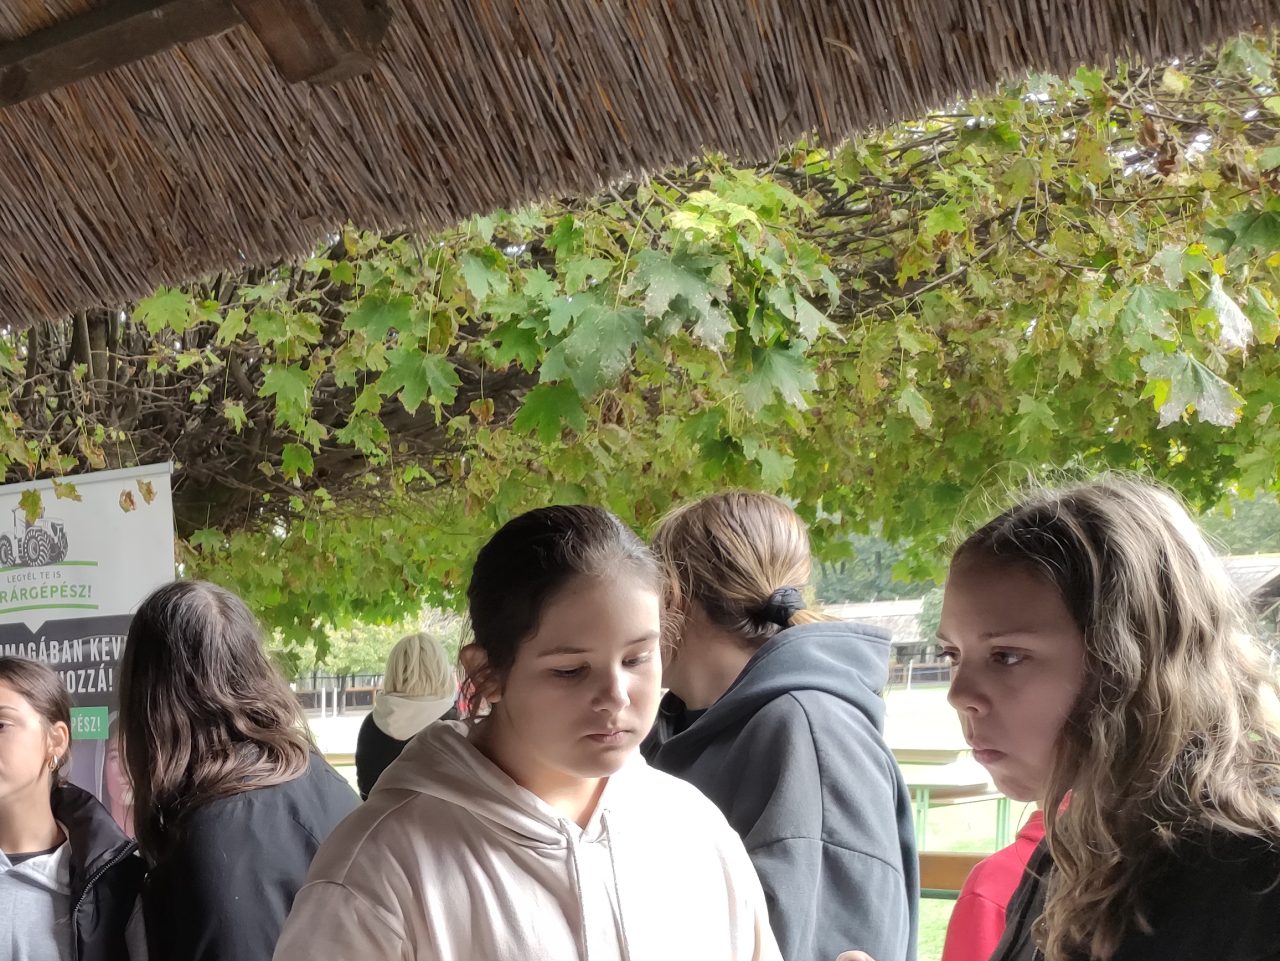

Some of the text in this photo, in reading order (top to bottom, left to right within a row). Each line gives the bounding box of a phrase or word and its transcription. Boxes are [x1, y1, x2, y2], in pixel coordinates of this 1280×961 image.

[7, 570, 62, 583] LEGYÉL TE IS
